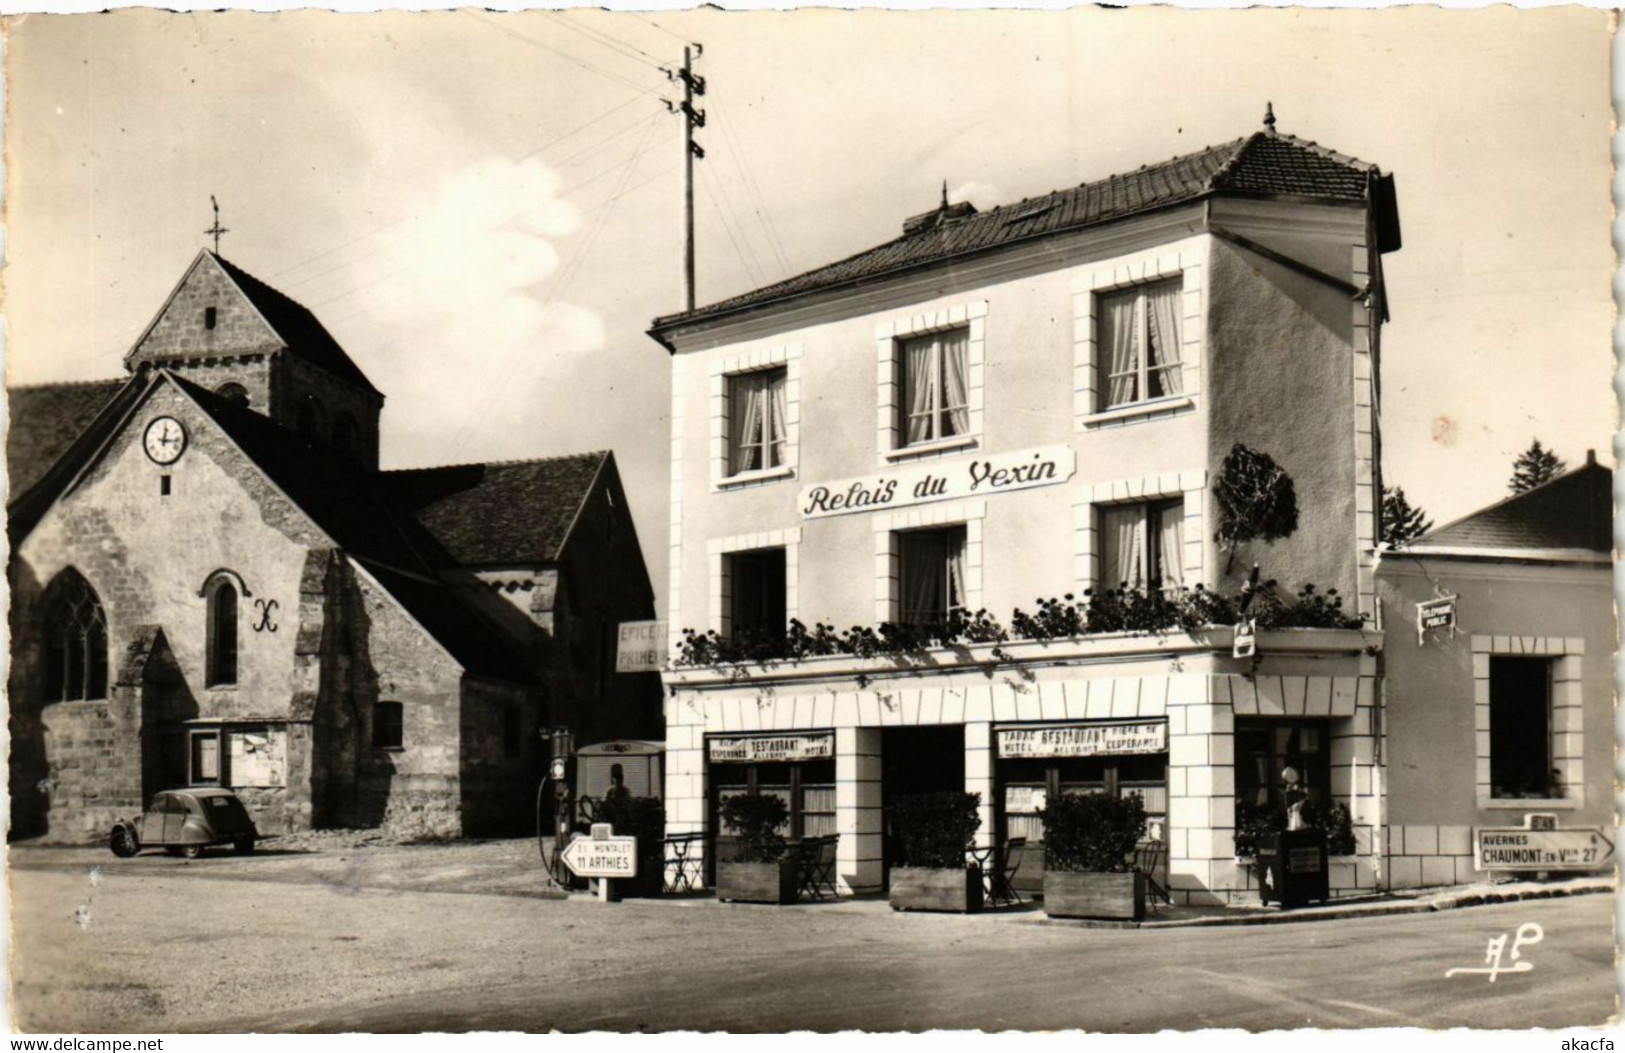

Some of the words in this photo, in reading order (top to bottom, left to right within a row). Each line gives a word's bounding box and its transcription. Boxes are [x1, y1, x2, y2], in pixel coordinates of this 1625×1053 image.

[803, 478, 898, 515] Relais
[913, 474, 948, 498] du
[969, 453, 1058, 491] Vexin
[1041, 728, 1107, 745] RESTAURANT
[1483, 835, 1528, 846] AVERNES
[1590, 834, 1598, 845] 6
[1582, 849, 1598, 862] 27
[577, 857, 586, 869] 11
[588, 856, 629, 870] ARTHIES
